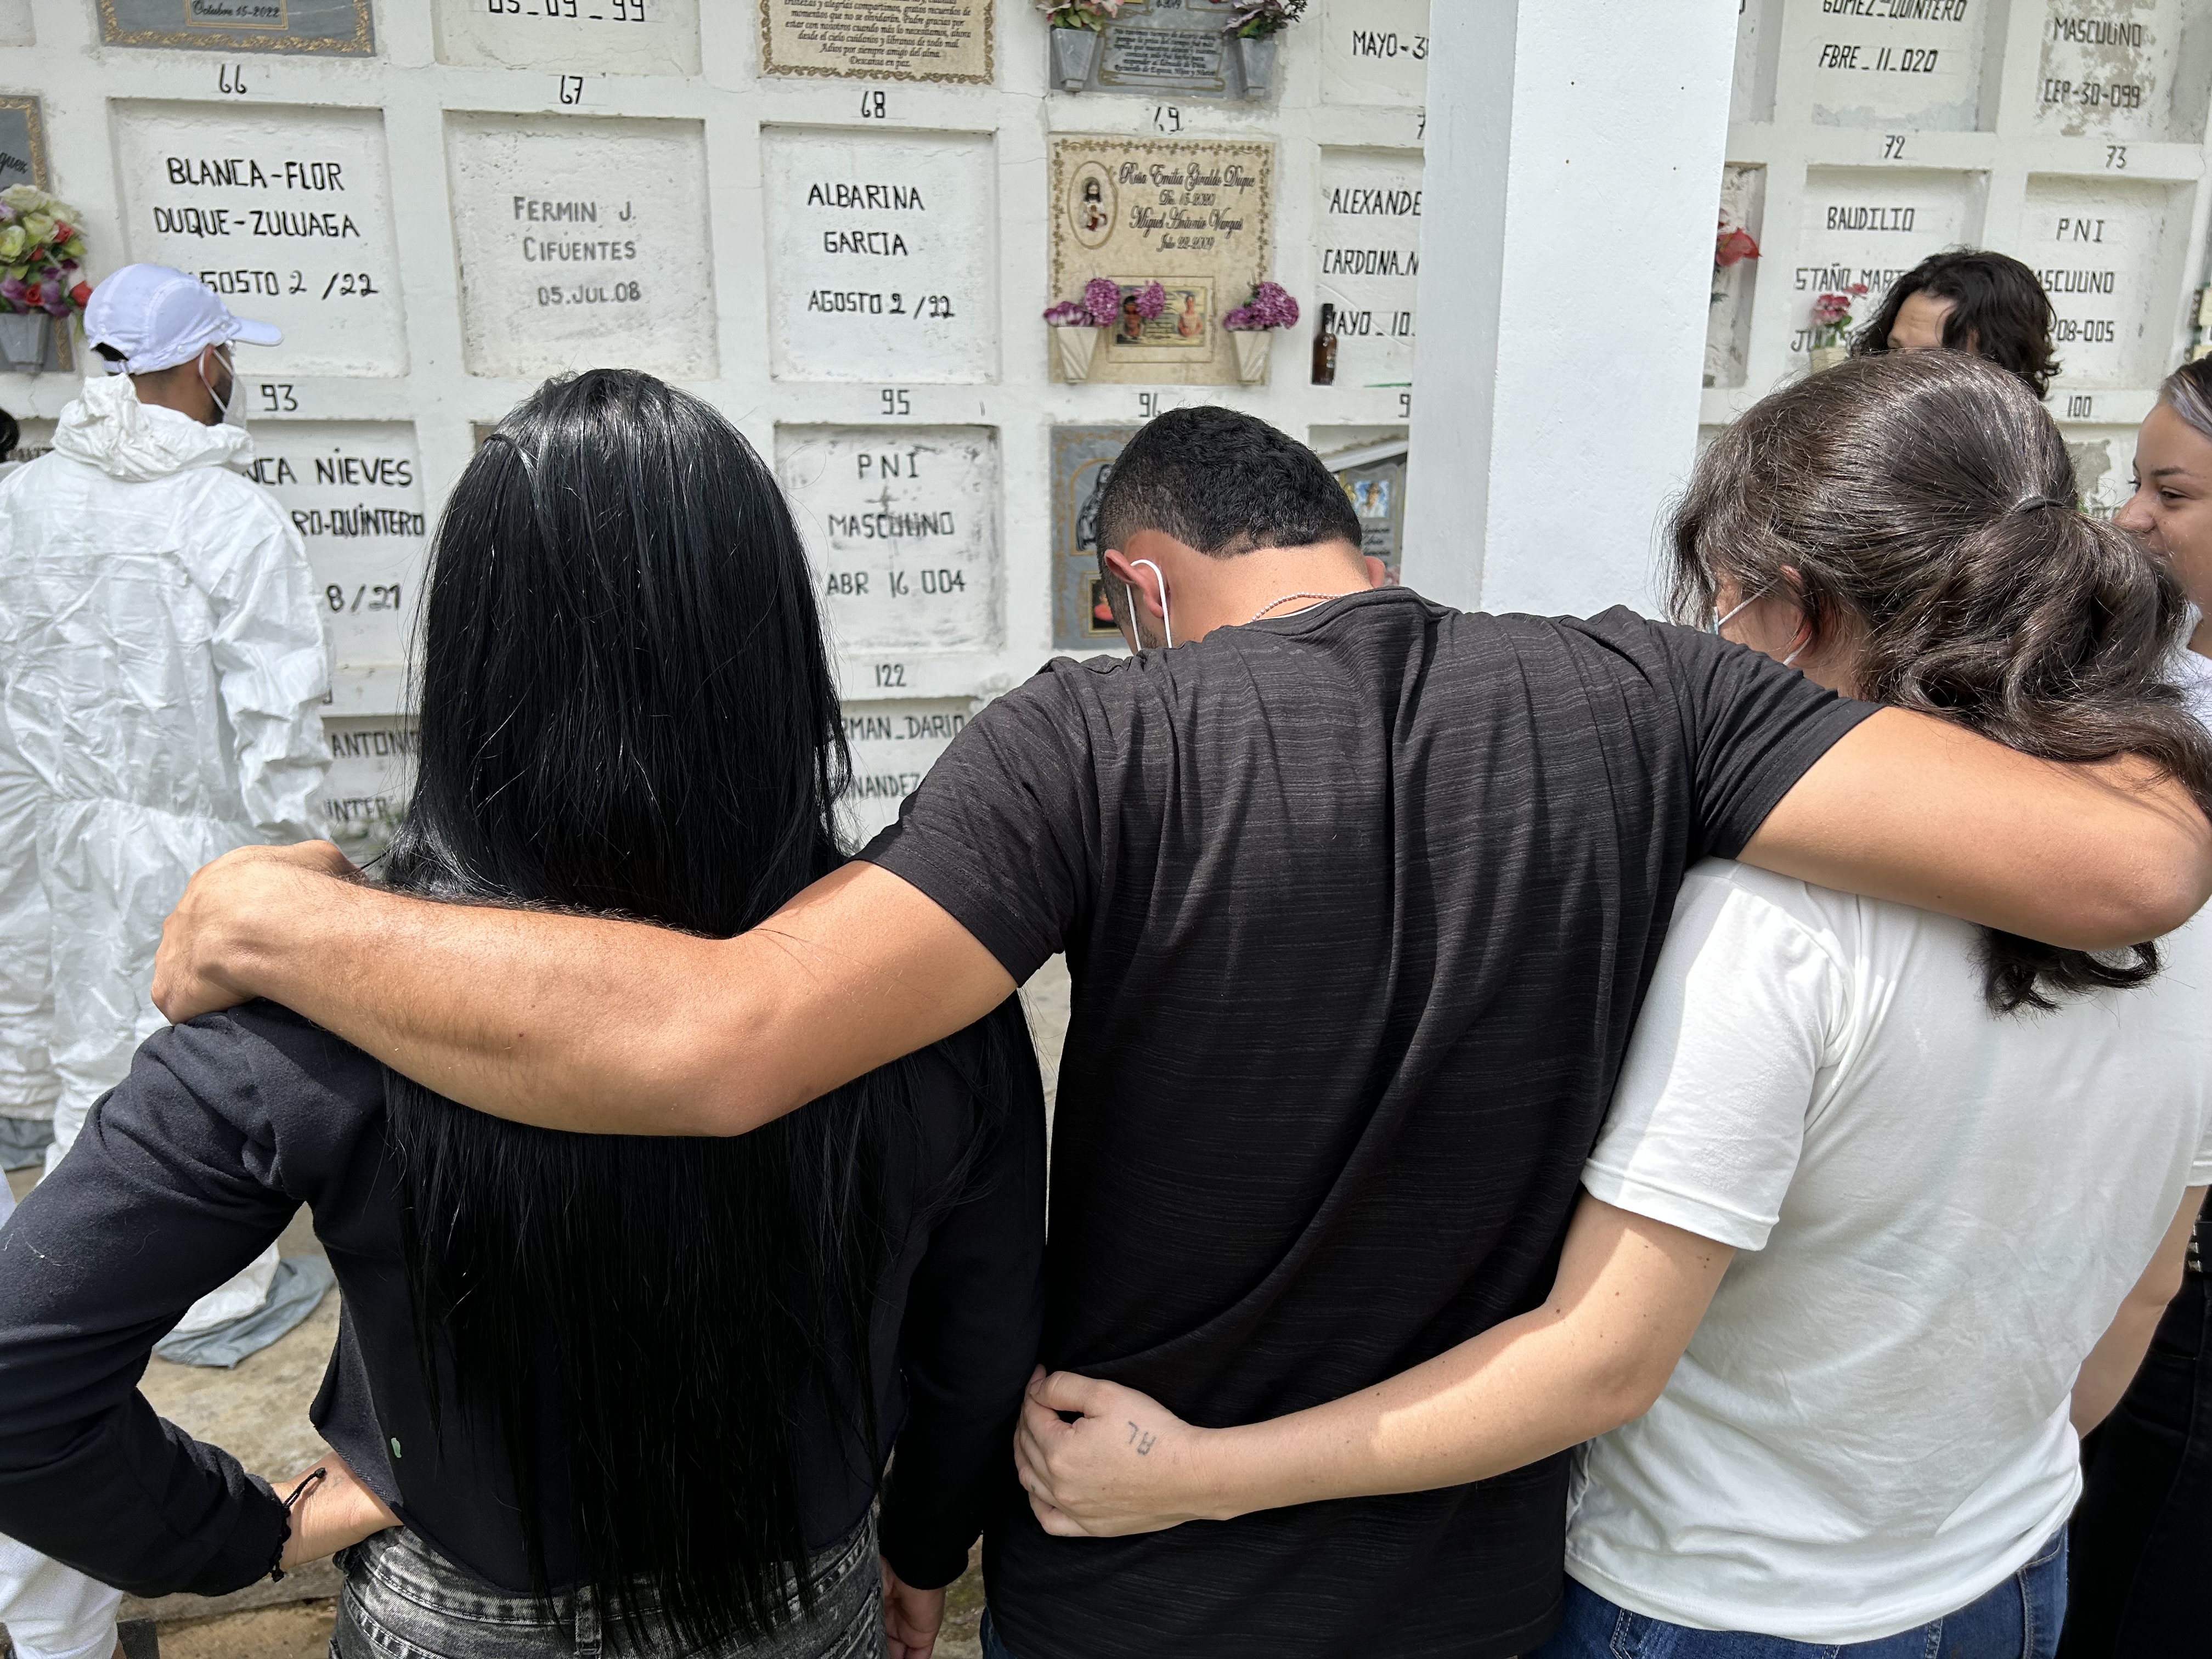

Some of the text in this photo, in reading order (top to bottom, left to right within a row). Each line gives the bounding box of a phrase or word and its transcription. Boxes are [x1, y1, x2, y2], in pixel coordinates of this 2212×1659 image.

[236, 6, 280, 18] 15-2022
[829, 13, 842, 22] que
[951, 20, 966, 29] por
[963, 7, 971, 16] de
[820, 31, 828, 41] el
[916, 37, 925, 46] de
[909, 47, 922, 57] del
[219, 63, 247, 94] 66
[560, 75, 583, 105] 67
[861, 91, 886, 119] 68
[1884, 135, 1906, 160] 72
[2106, 145, 2128, 170] 73
[514, 196, 597, 223] FERMIN
[808, 183, 926, 211] ALBARINA
[1329, 188, 1422, 216] ALEXANDE
[1827, 206, 1916, 232] BAUDILIO
[523, 236, 636, 262] CIFUENTES
[824, 230, 909, 257] GARCIA
[189, 269, 280, 295] GOSTO
[289, 270, 307, 295] 2
[808, 290, 883, 315] AGOSTO
[889, 293, 907, 315] 2
[261, 383, 298, 412] 93
[882, 388, 910, 416] 95
[1398, 393, 1410, 417] 9
[2067, 395, 2092, 418] 100
[827, 568, 966, 598] ABR 16 004
[875, 663, 907, 688] 122
